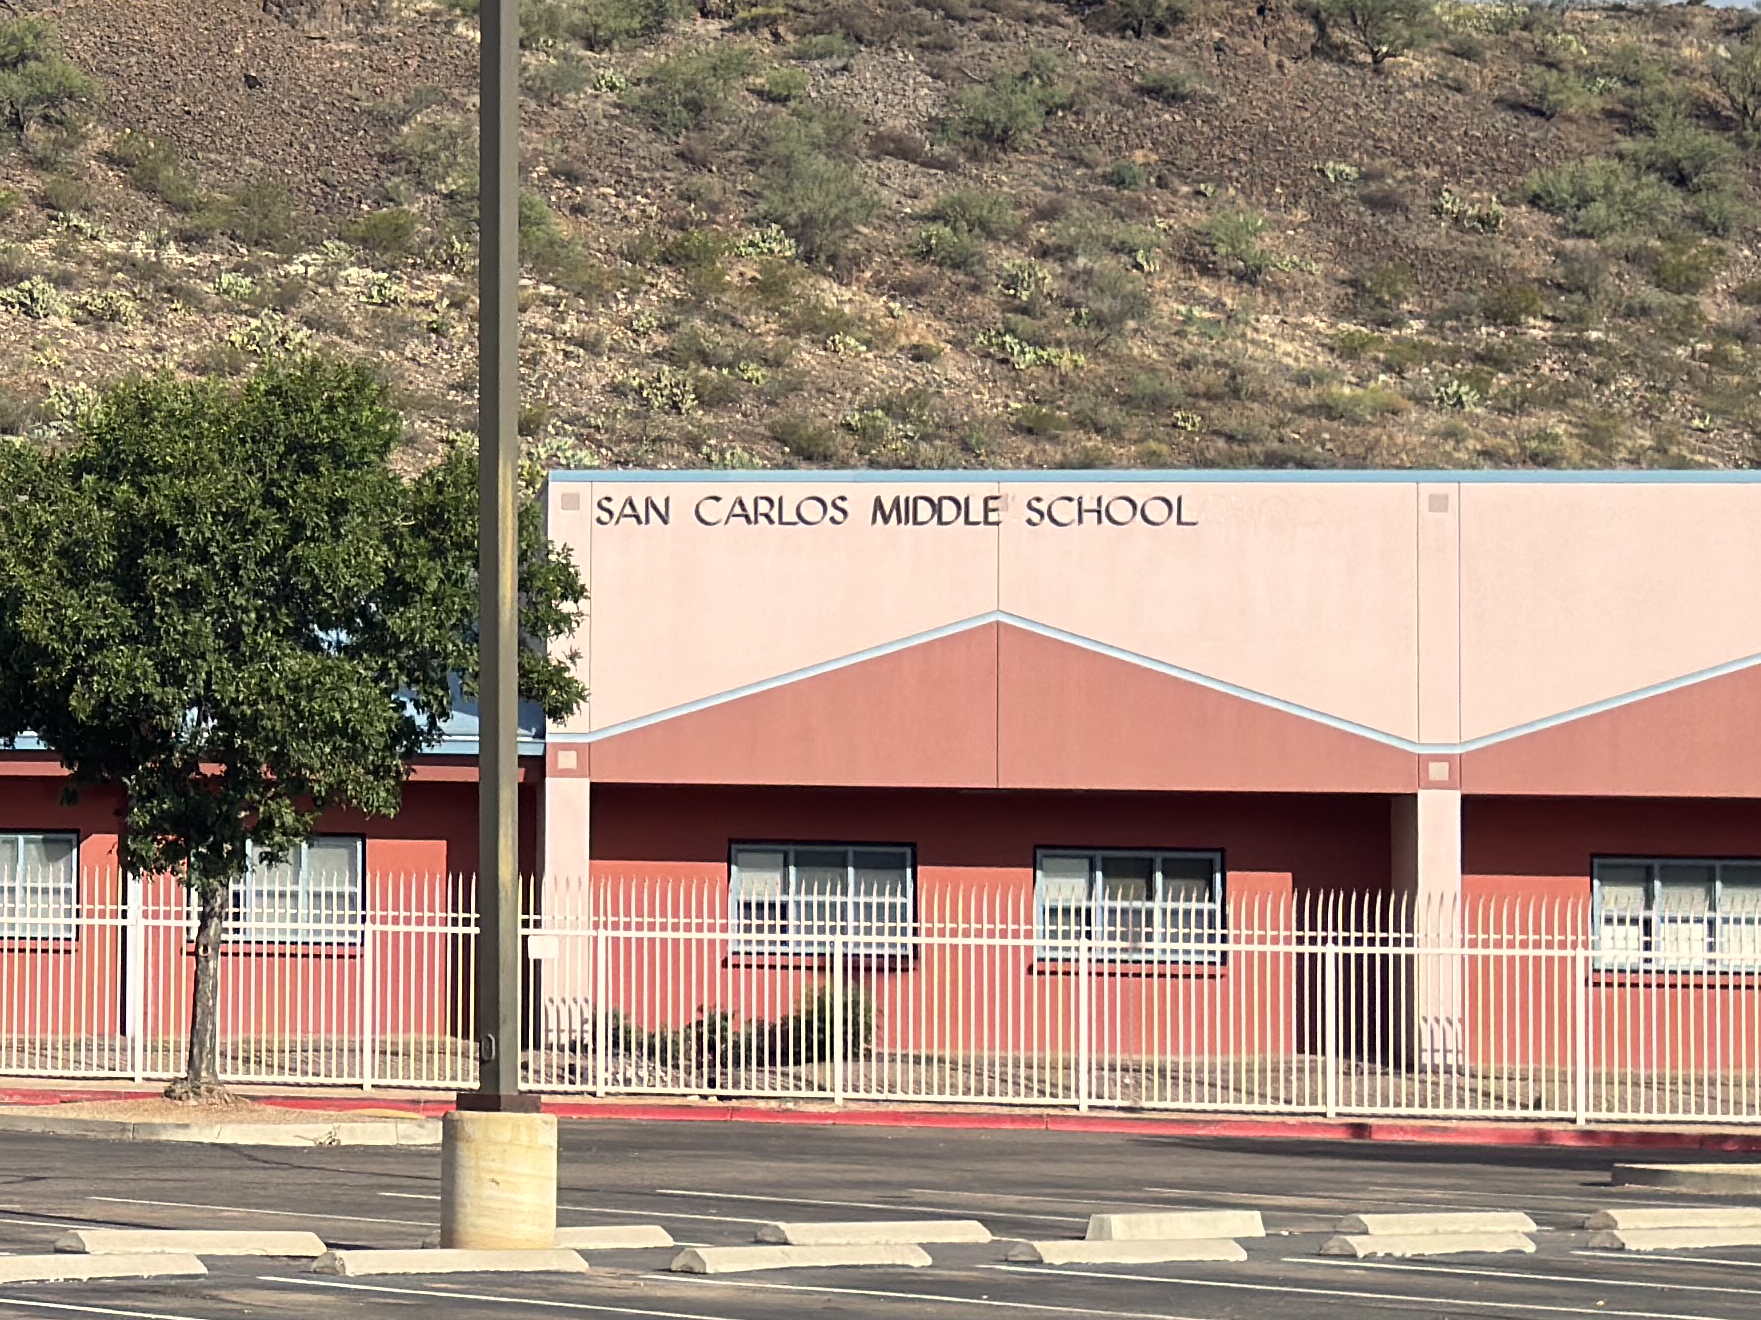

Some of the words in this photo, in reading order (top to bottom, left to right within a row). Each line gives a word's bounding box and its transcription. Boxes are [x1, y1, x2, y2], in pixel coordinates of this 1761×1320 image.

[594, 494, 671, 527] SAN
[693, 494, 850, 527] CARLOS
[870, 494, 1003, 527] MIDDLE
[1024, 494, 1200, 528] SCHOOL
